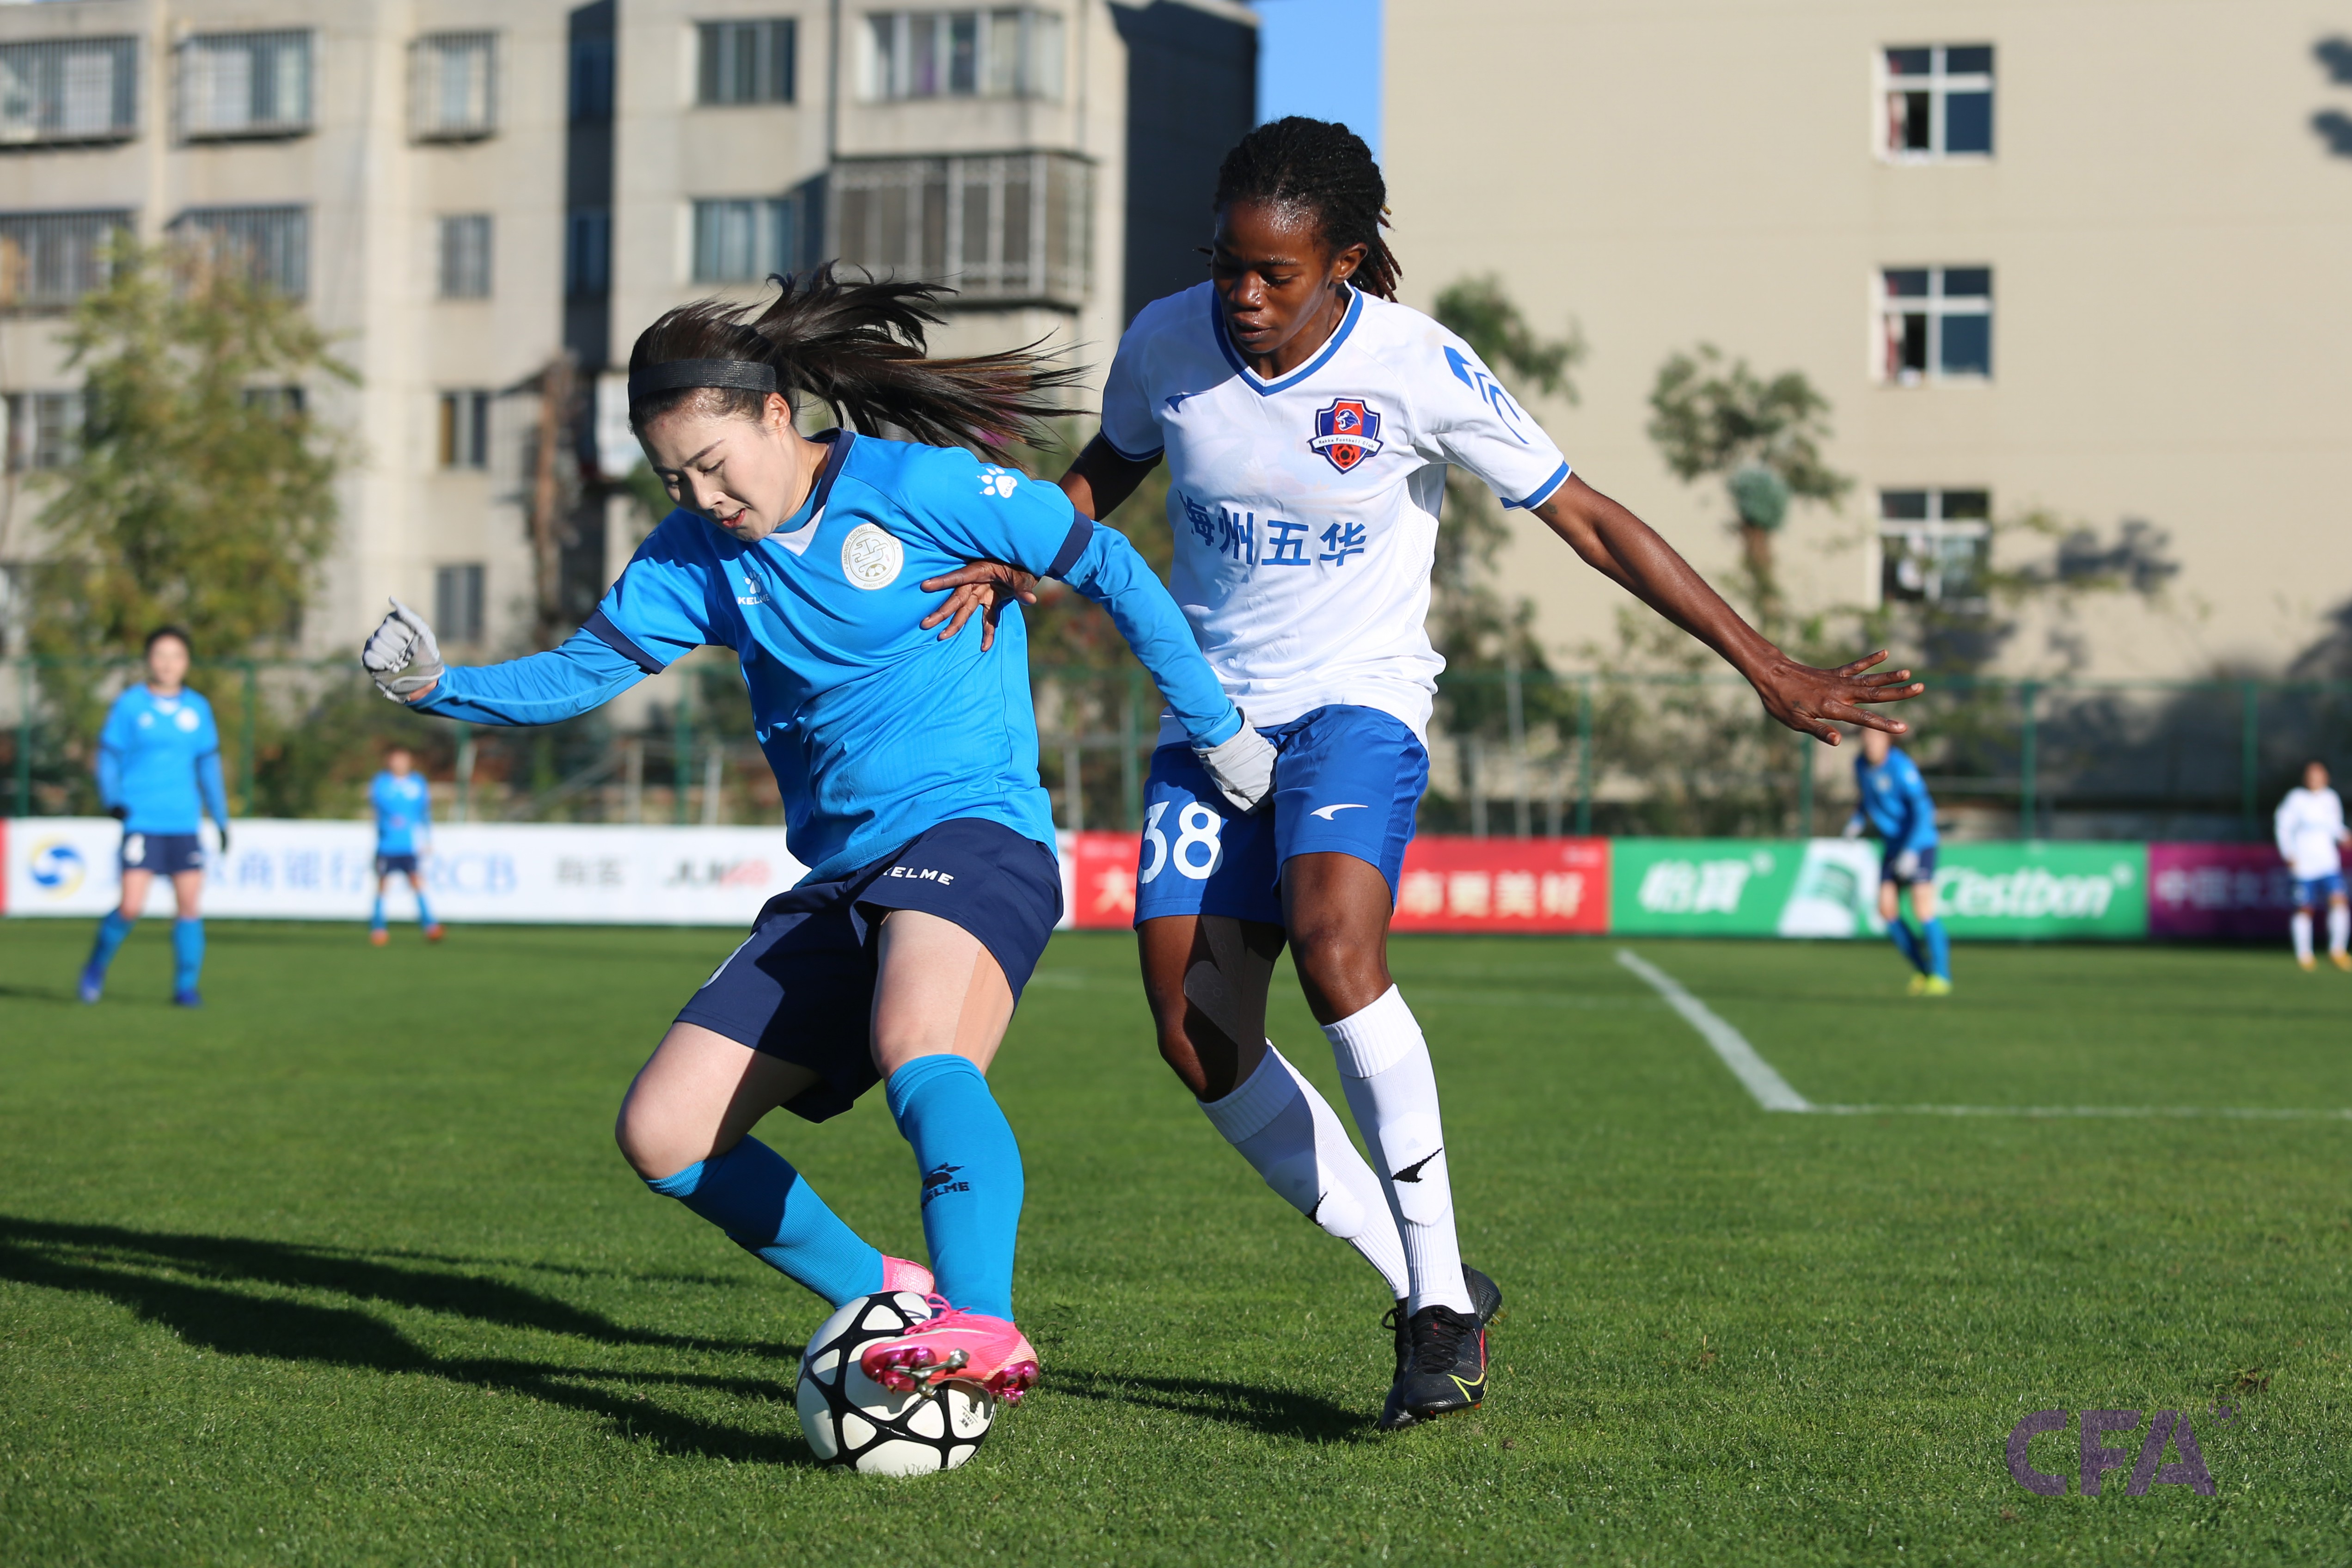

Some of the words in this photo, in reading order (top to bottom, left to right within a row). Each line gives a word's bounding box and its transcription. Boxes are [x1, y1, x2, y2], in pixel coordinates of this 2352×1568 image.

[843, 541, 851, 565] JIANGNING
[849, 526, 868, 542] FOOTBALL
[1177, 489, 1366, 567] 梅州五华
[737, 594, 770, 605] KELME
[1138, 801, 1224, 884] 38
